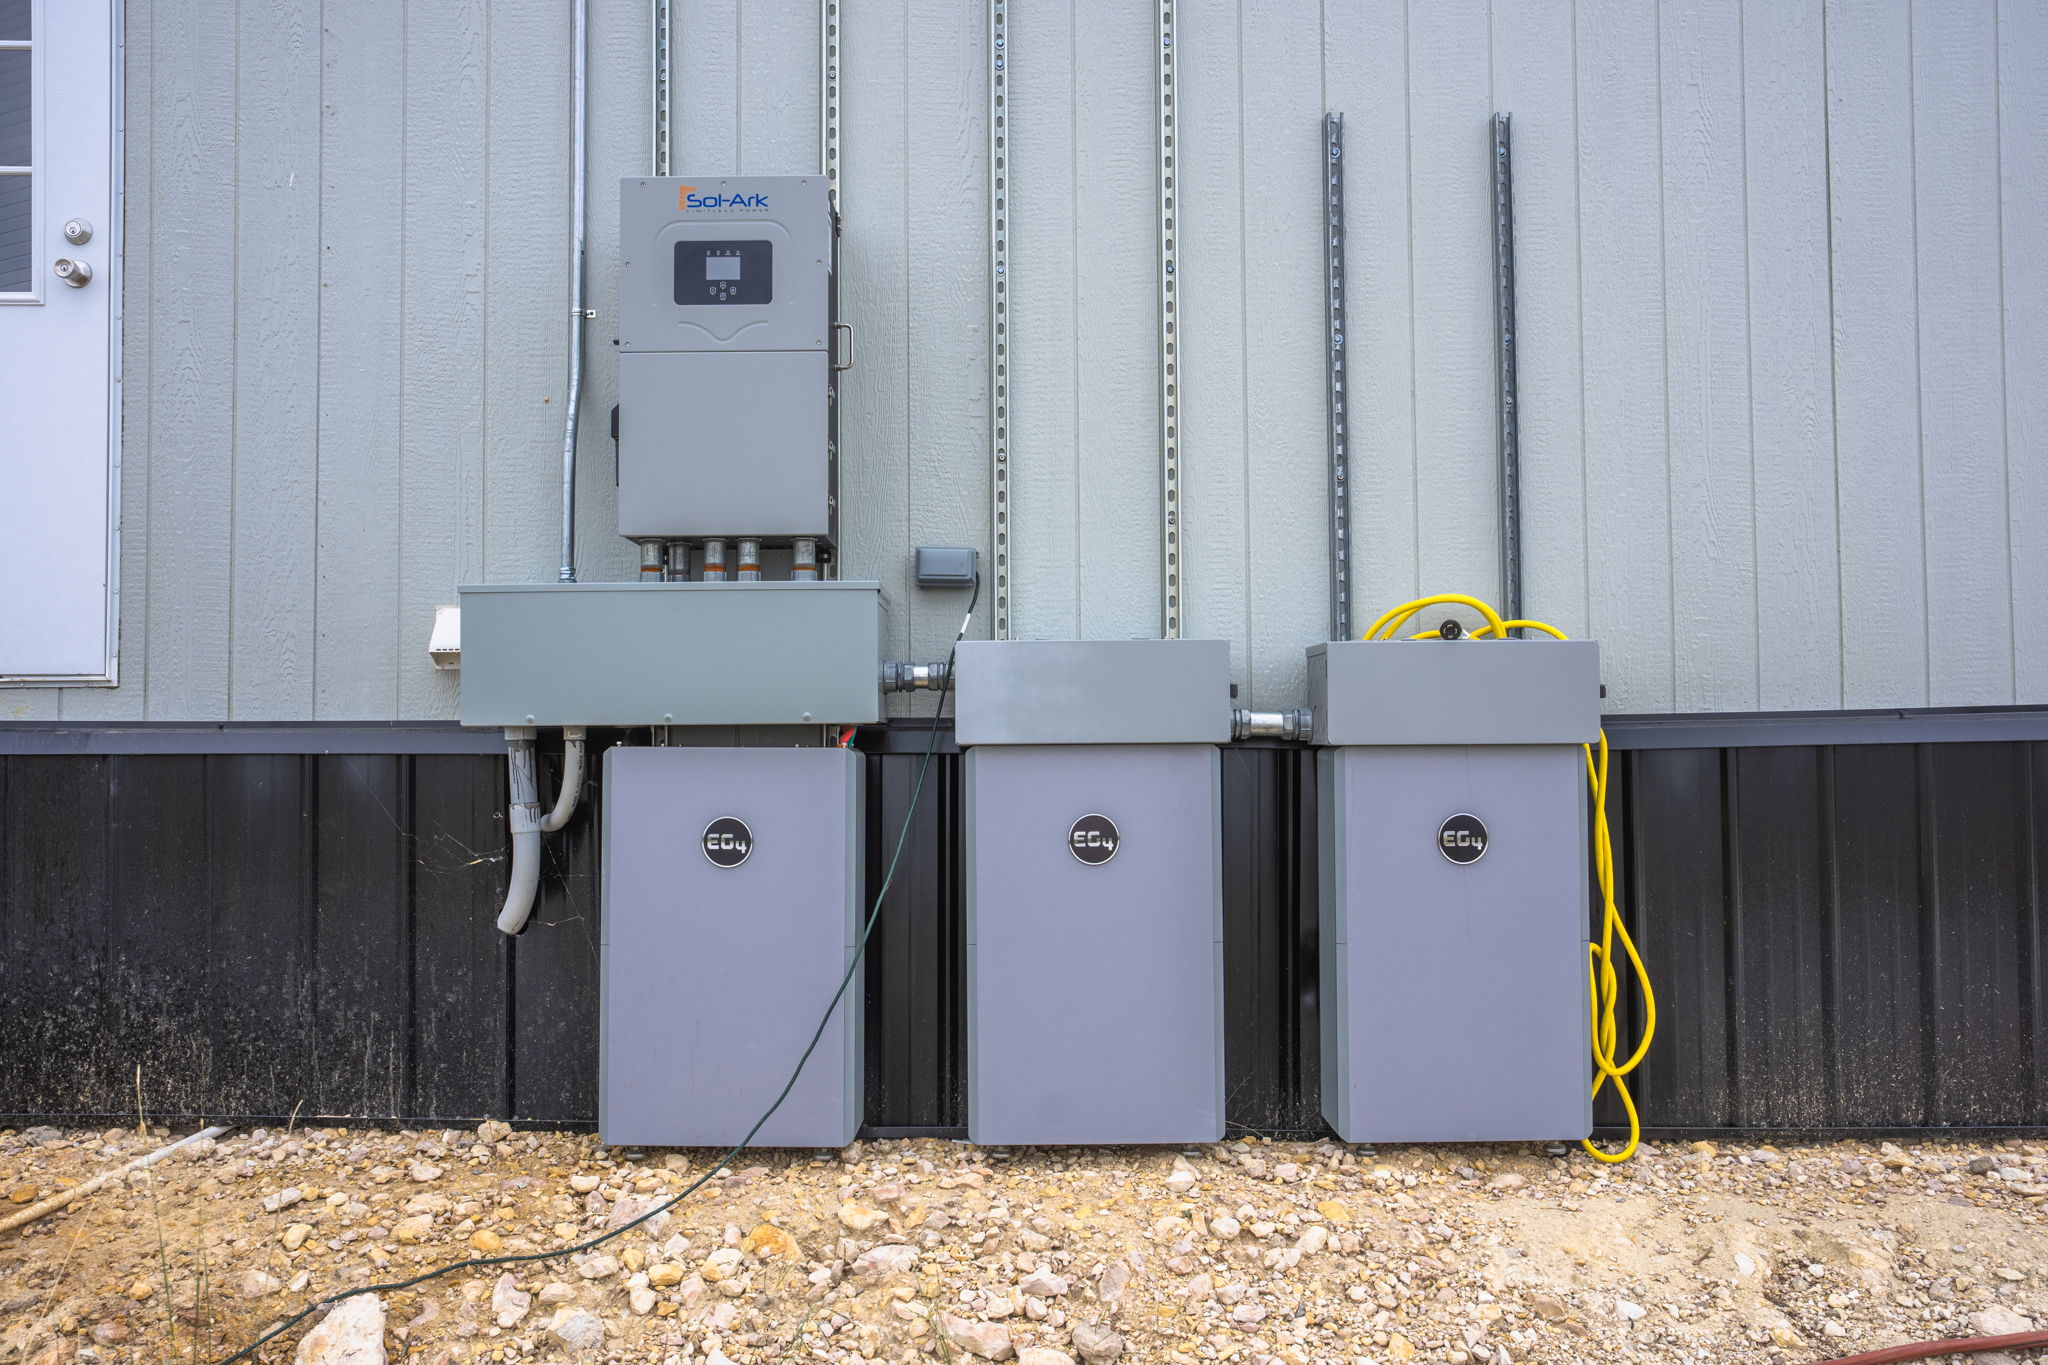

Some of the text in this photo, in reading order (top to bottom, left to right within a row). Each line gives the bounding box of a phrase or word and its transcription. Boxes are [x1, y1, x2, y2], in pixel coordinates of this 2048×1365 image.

[686, 193, 769, 208] Sol-Ark
[707, 833, 747, 854] EG4
[1073, 831, 1114, 851] EG4
[1443, 830, 1483, 850] EG4
